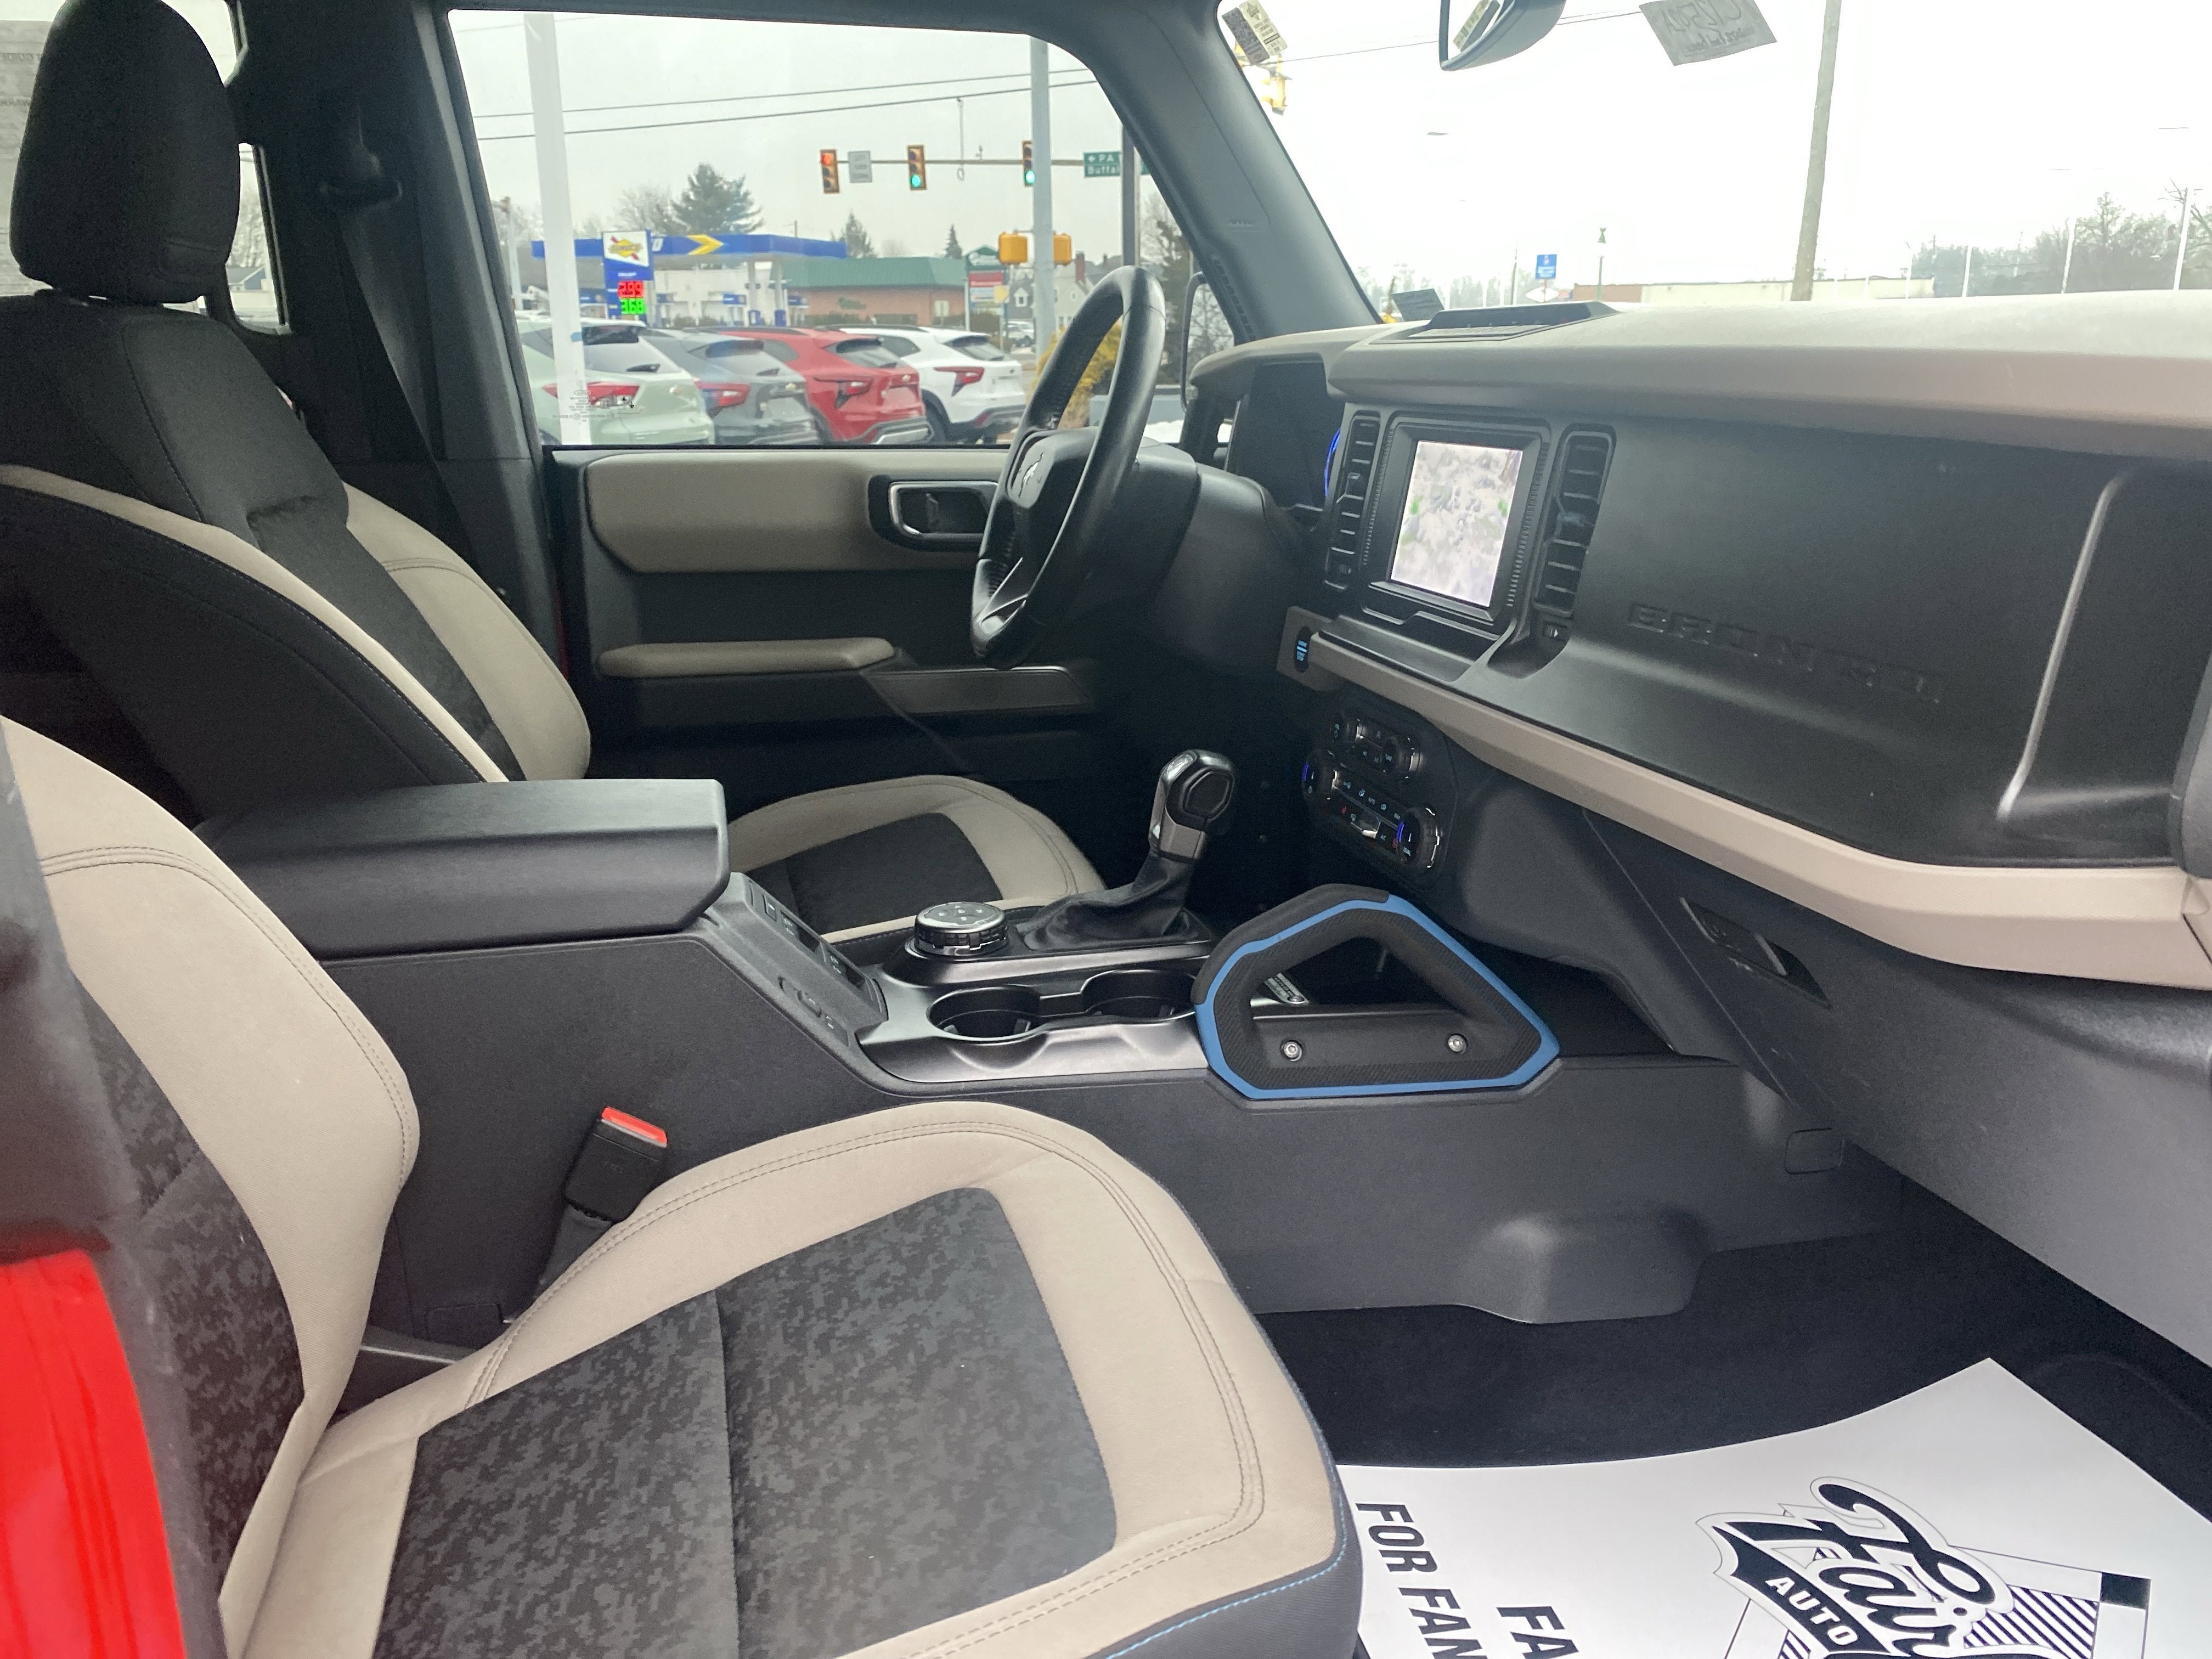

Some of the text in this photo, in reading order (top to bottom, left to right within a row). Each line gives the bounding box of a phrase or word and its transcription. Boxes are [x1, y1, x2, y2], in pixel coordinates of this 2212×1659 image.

[1098, 154, 1114, 162] PA
[1355, 1503, 1438, 1573] FOR
[1764, 1576, 1858, 1646] AUTO
